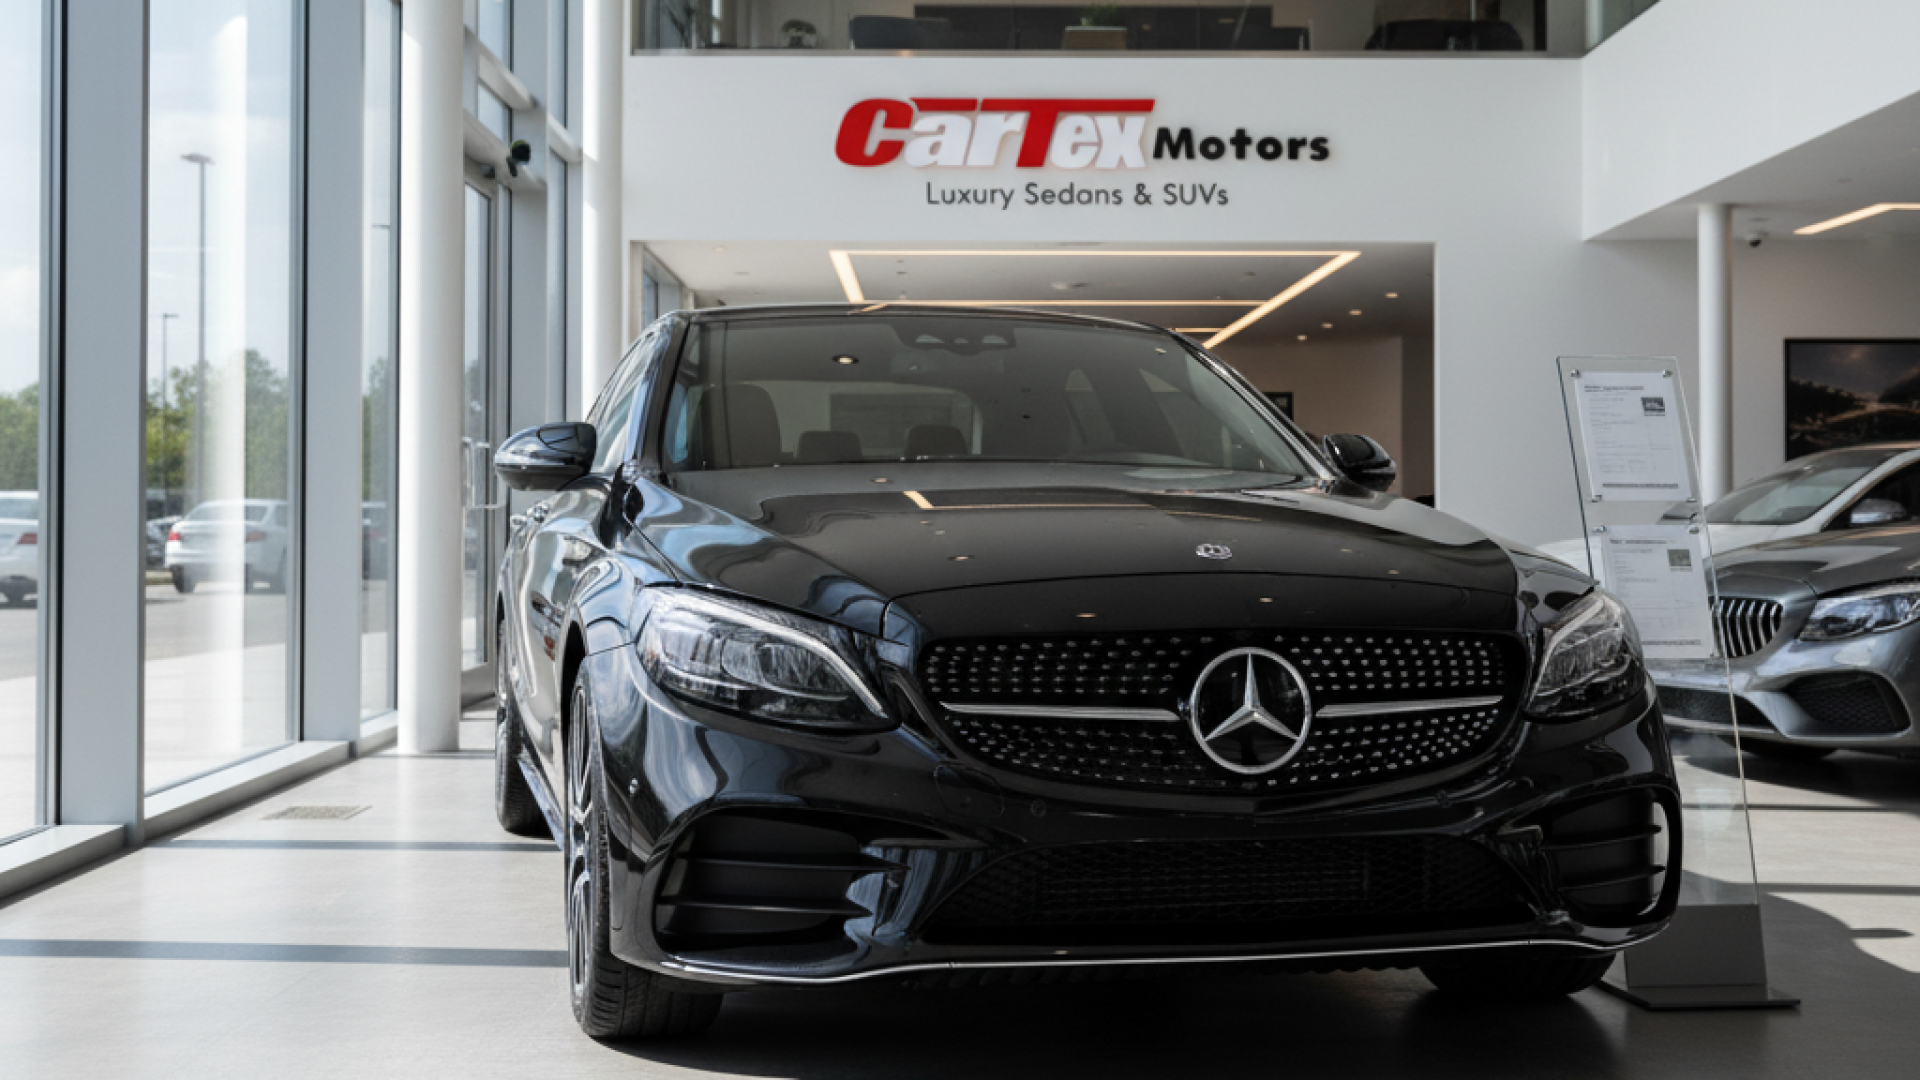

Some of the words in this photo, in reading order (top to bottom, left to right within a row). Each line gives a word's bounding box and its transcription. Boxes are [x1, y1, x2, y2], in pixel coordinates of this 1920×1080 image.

[835, 97, 1155, 169] CarTex
[1152, 126, 1330, 161] Motors
[926, 181, 1015, 211] Luxury
[1024, 181, 1124, 206] Sedans
[1133, 182, 1153, 206] &
[1163, 182, 1229, 206] SUVs
